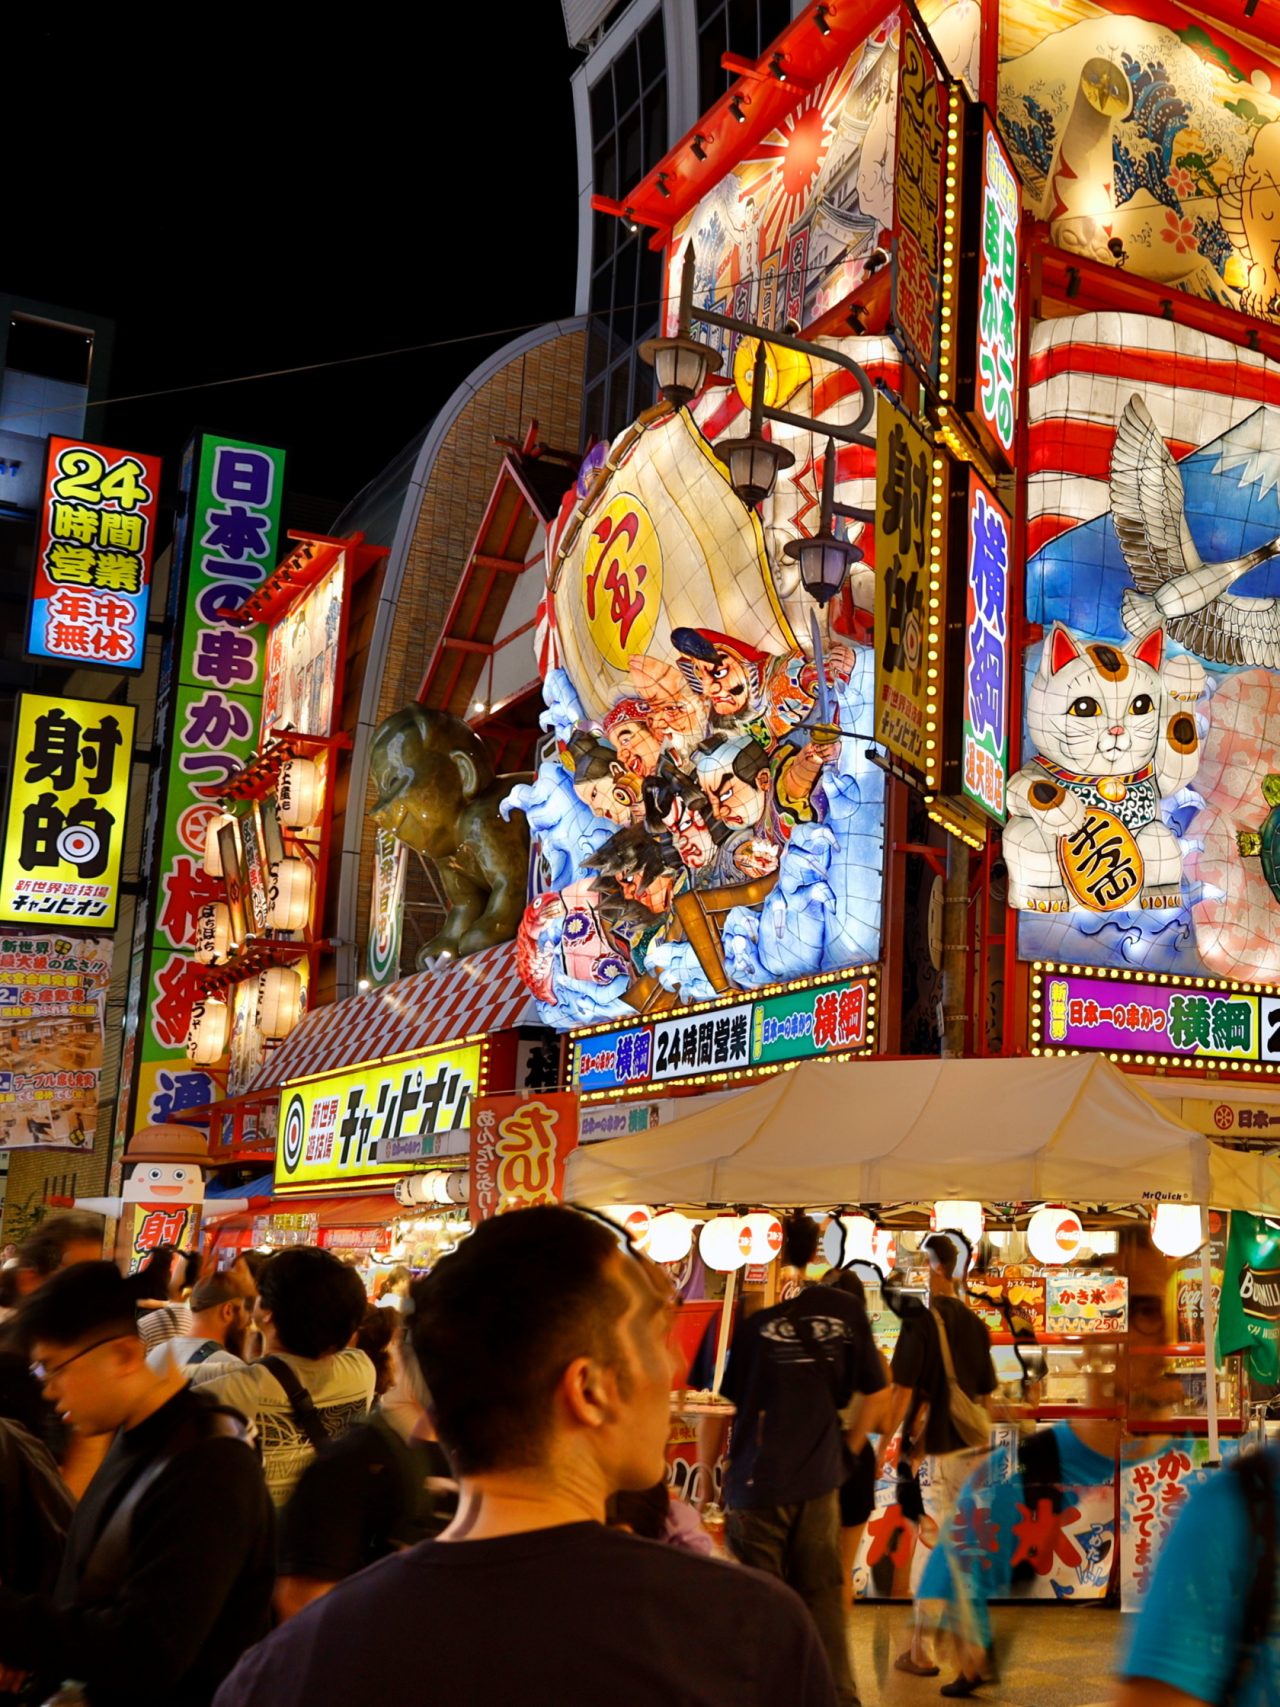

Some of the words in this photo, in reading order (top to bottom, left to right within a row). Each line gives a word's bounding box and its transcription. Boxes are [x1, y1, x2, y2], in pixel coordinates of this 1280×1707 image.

[58, 450, 149, 509] 24
[52, 502, 147, 550] 時間
[48, 544, 141, 593] 営業
[882, 422, 929, 697] 射的
[51, 591, 133, 625] 年中
[967, 487, 1008, 758] 横綱
[49, 622, 134, 658] 無休
[18, 708, 123, 880] 射的
[11, 894, 109, 918] チャンピオン
[15, 880, 110, 899] 新世界遊技場
[814, 985, 865, 1048] 横綱
[1068, 999, 1167, 1032] 日本一の串かつ
[1168, 994, 1253, 1053] 横綱
[616, 1031, 651, 1081] 横綱
[655, 1014, 748, 1074] 24時間営業
[1142, 1191, 1183, 1200] MrQuick
[1059, 1288, 1107, 1306] かき氷
